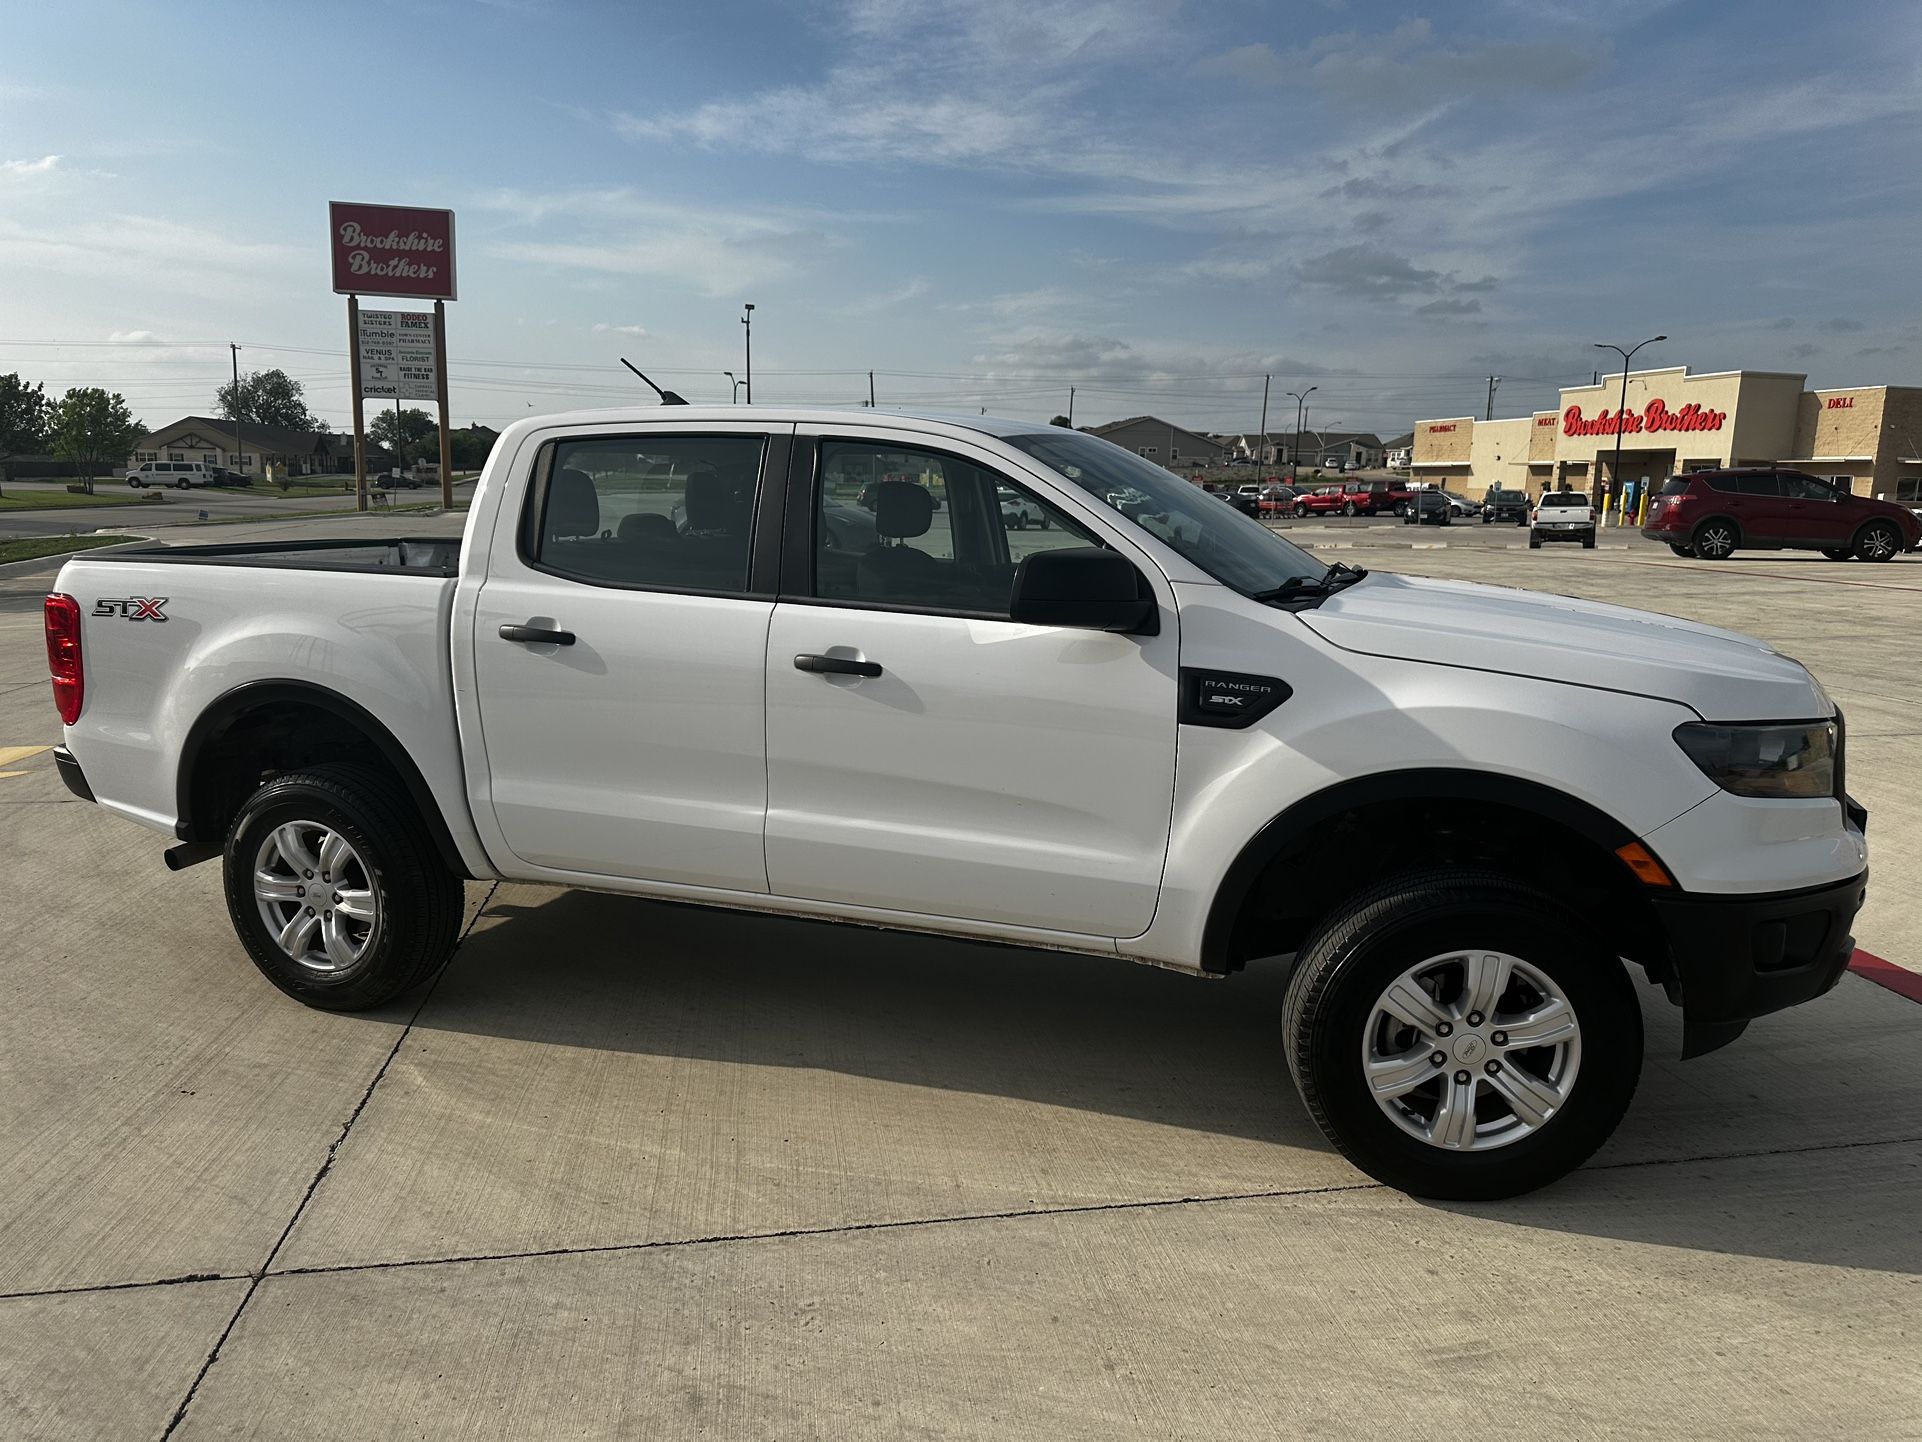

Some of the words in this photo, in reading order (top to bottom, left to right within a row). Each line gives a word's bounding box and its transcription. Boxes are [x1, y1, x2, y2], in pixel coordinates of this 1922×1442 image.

[340, 222, 443, 252] Brookshire
[348, 250, 437, 278] Brothers
[360, 329, 395, 338] iTumble
[1828, 397, 1854, 409] DELI
[1563, 405, 1644, 436] Brookshire
[1644, 398, 1726, 433] Brothers
[92, 596, 169, 622] STX
[1205, 680, 1271, 692] RANGER
[1209, 696, 1244, 706] STX
